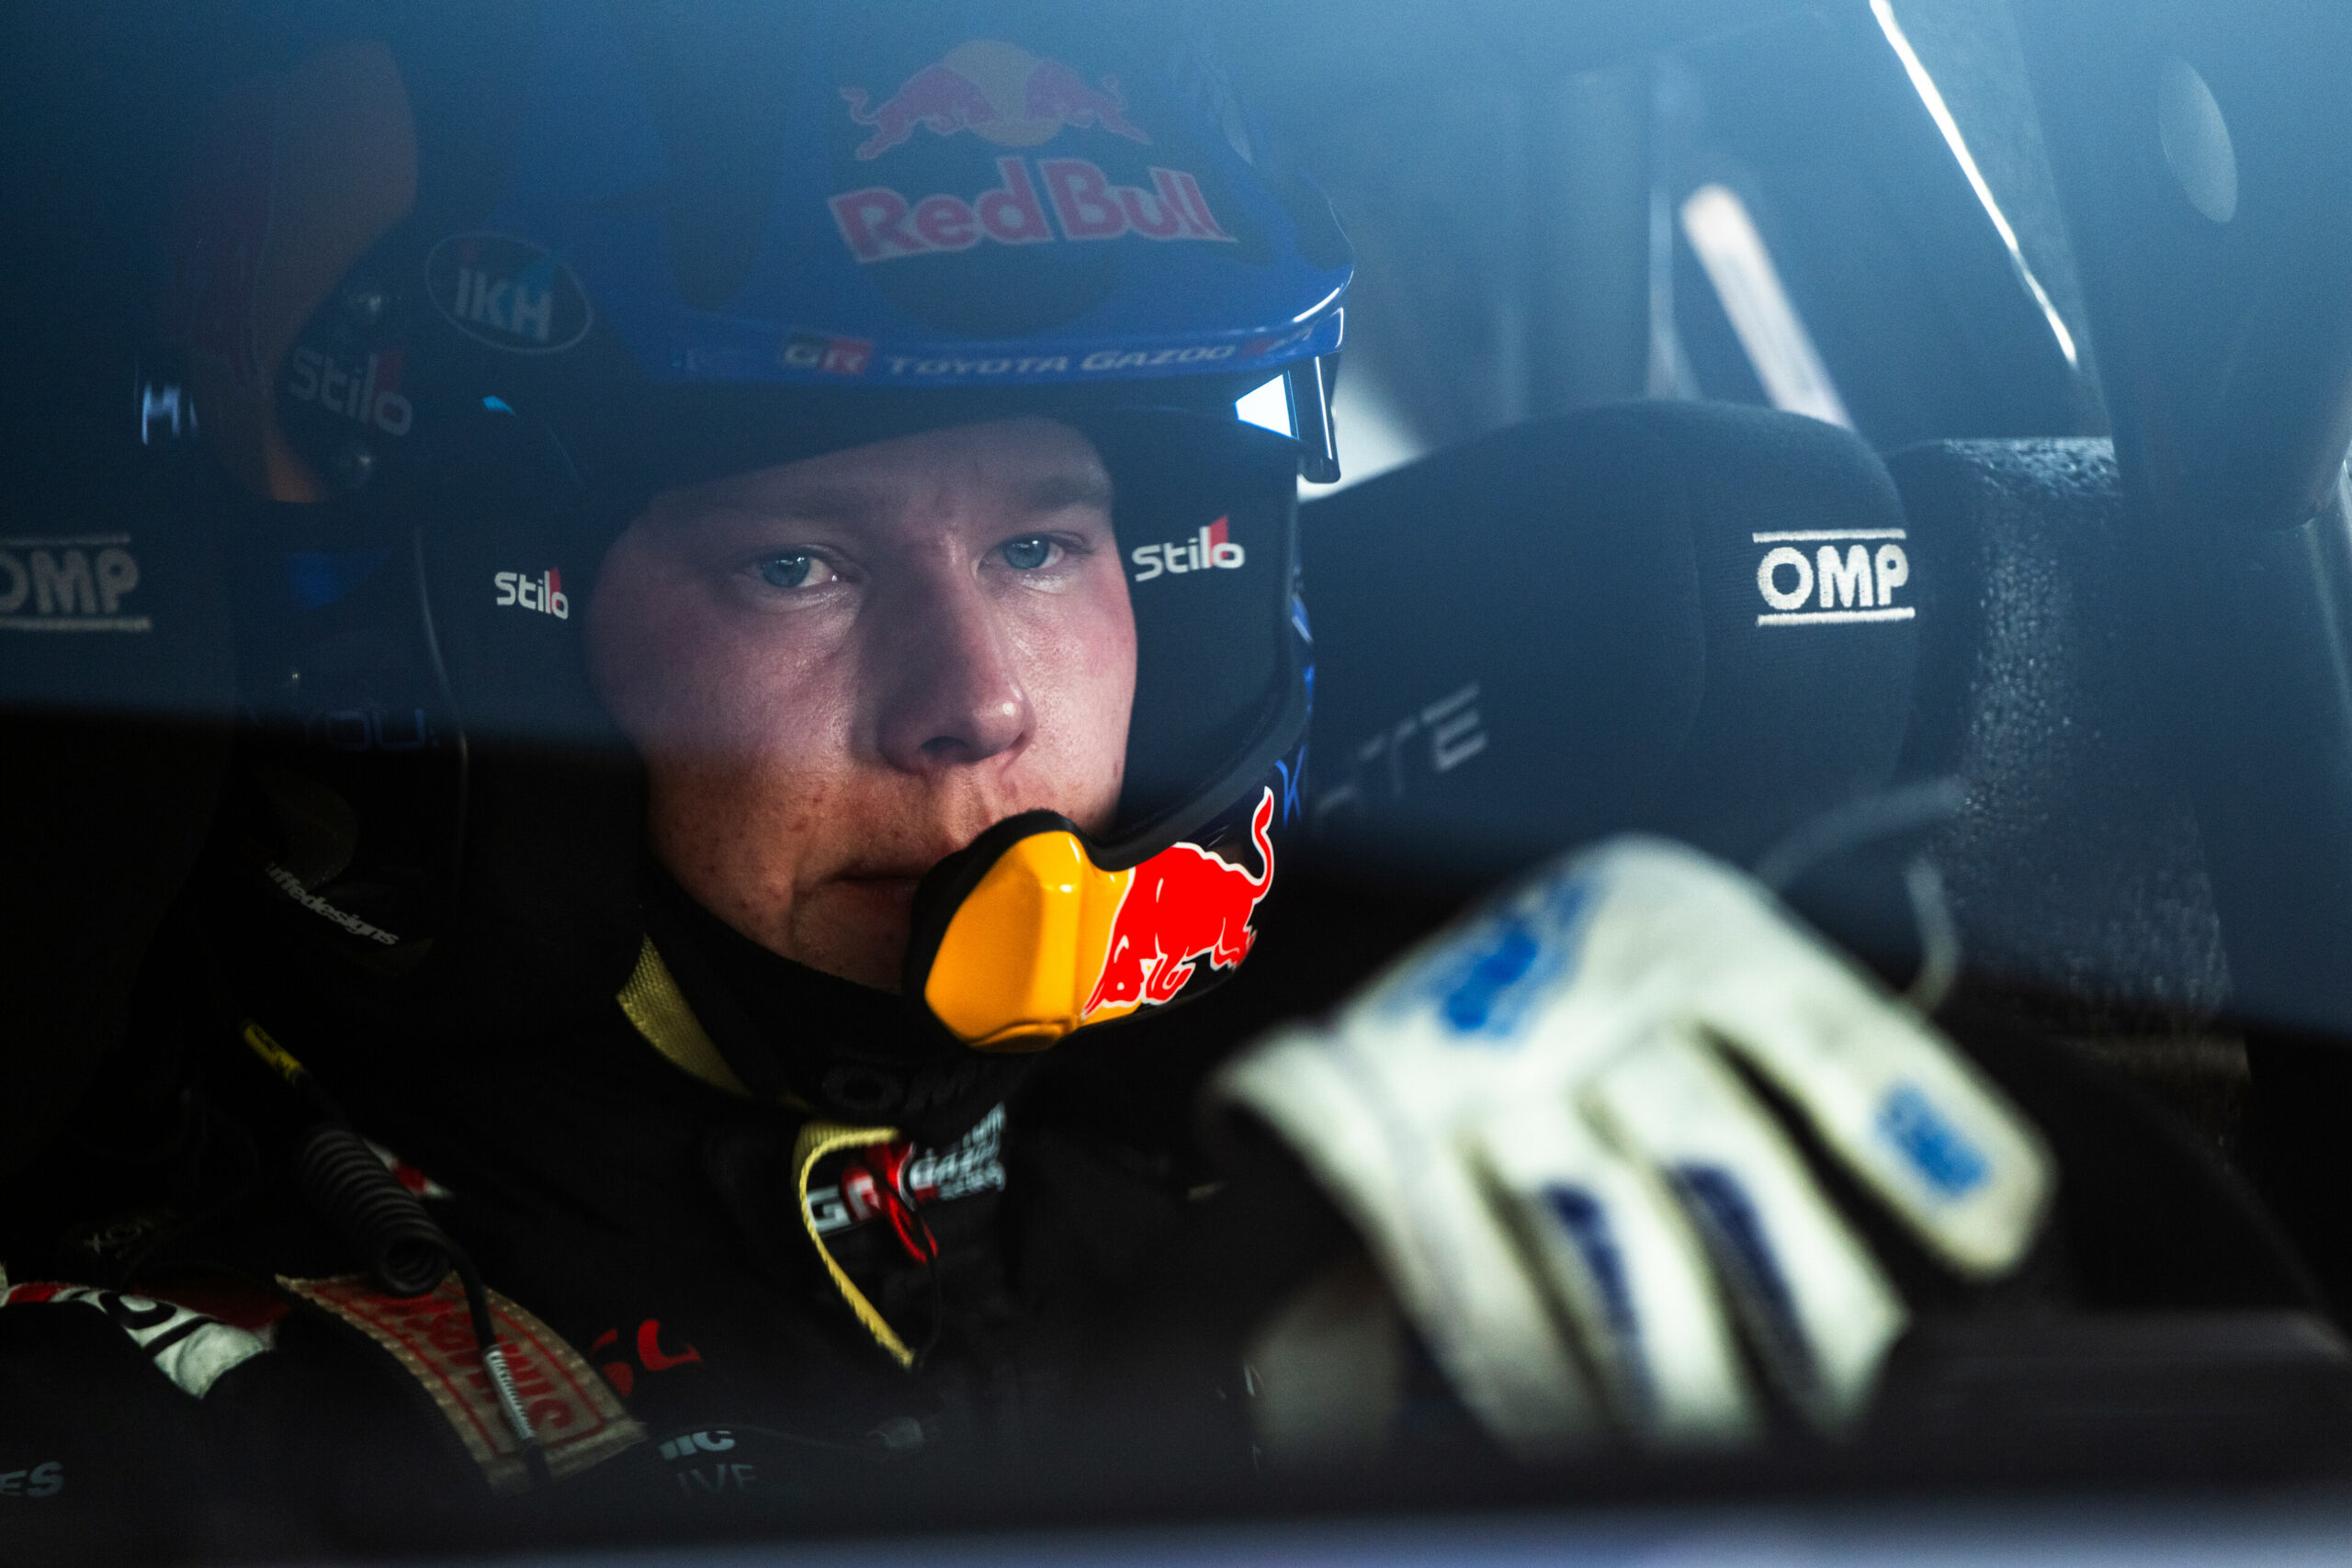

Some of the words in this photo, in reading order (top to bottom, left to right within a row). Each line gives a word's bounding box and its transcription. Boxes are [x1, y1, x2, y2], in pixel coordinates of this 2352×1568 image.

[830, 156, 1054, 264] Red
[1038, 158, 1238, 243] Bull
[455, 267, 552, 342] IKH
[288, 346, 413, 438] Stilo
[885, 355, 1069, 375] TOYOTA
[1080, 344, 1238, 372] GAZOO
[1132, 525, 1246, 582] Stilo
[1757, 542, 1910, 612] OMP
[494, 569, 569, 620] Stilo
